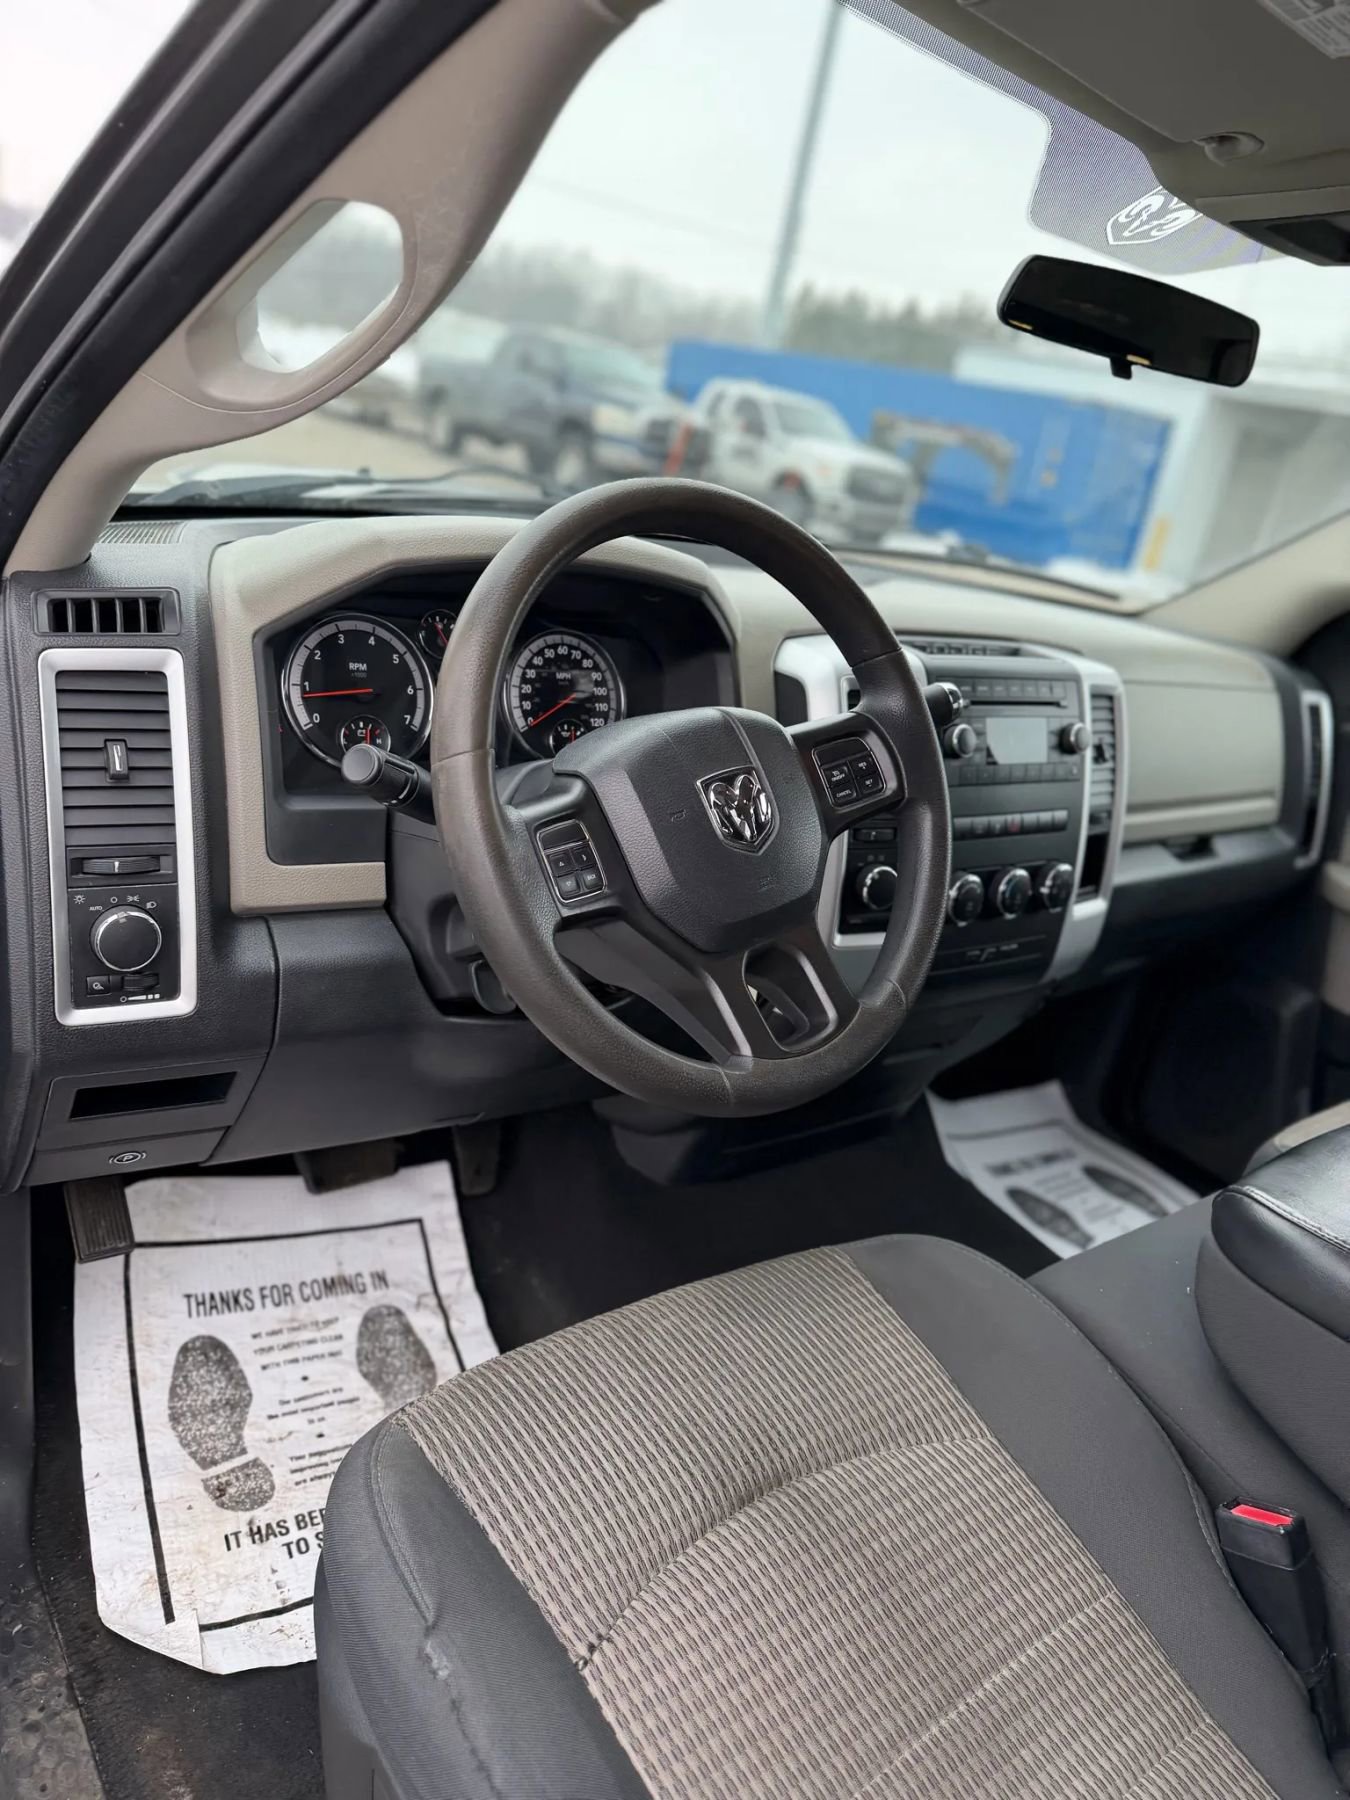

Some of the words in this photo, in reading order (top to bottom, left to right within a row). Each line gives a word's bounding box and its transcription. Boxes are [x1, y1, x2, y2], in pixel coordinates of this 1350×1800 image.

[338, 634, 345, 644] 3
[368, 636, 376, 646] 4
[544, 649, 555, 658] 50
[557, 645, 568, 655] 60
[314, 651, 321, 660] 2
[392, 654, 399, 664] 5
[571, 650, 582, 660] 70
[532, 656, 543, 666] 40
[582, 659, 593, 668] 80
[349, 662, 367, 671] RPM
[525, 669, 536, 678] 30
[555, 672, 571, 680] MPH
[591, 672, 602, 681] 90
[304, 681, 310, 691] 1
[407, 685, 414, 694] 6
[521, 685, 532, 694] 20
[593, 687, 608, 696] 100
[522, 701, 531, 710] 10
[595, 702, 609, 712] 110
[313, 713, 320, 723] 0
[404, 715, 411, 724] 7
[590, 718, 605, 727] 120
[184, 1288, 255, 1319] THANKS
[259, 1283, 295, 1309] FOR
[299, 1272, 367, 1303] COMING
[370, 1269, 390, 1291] IN
[224, 1530, 242, 1552] IT
[249, 1519, 290, 1544] HAS
[281, 1537, 310, 1559] TO
